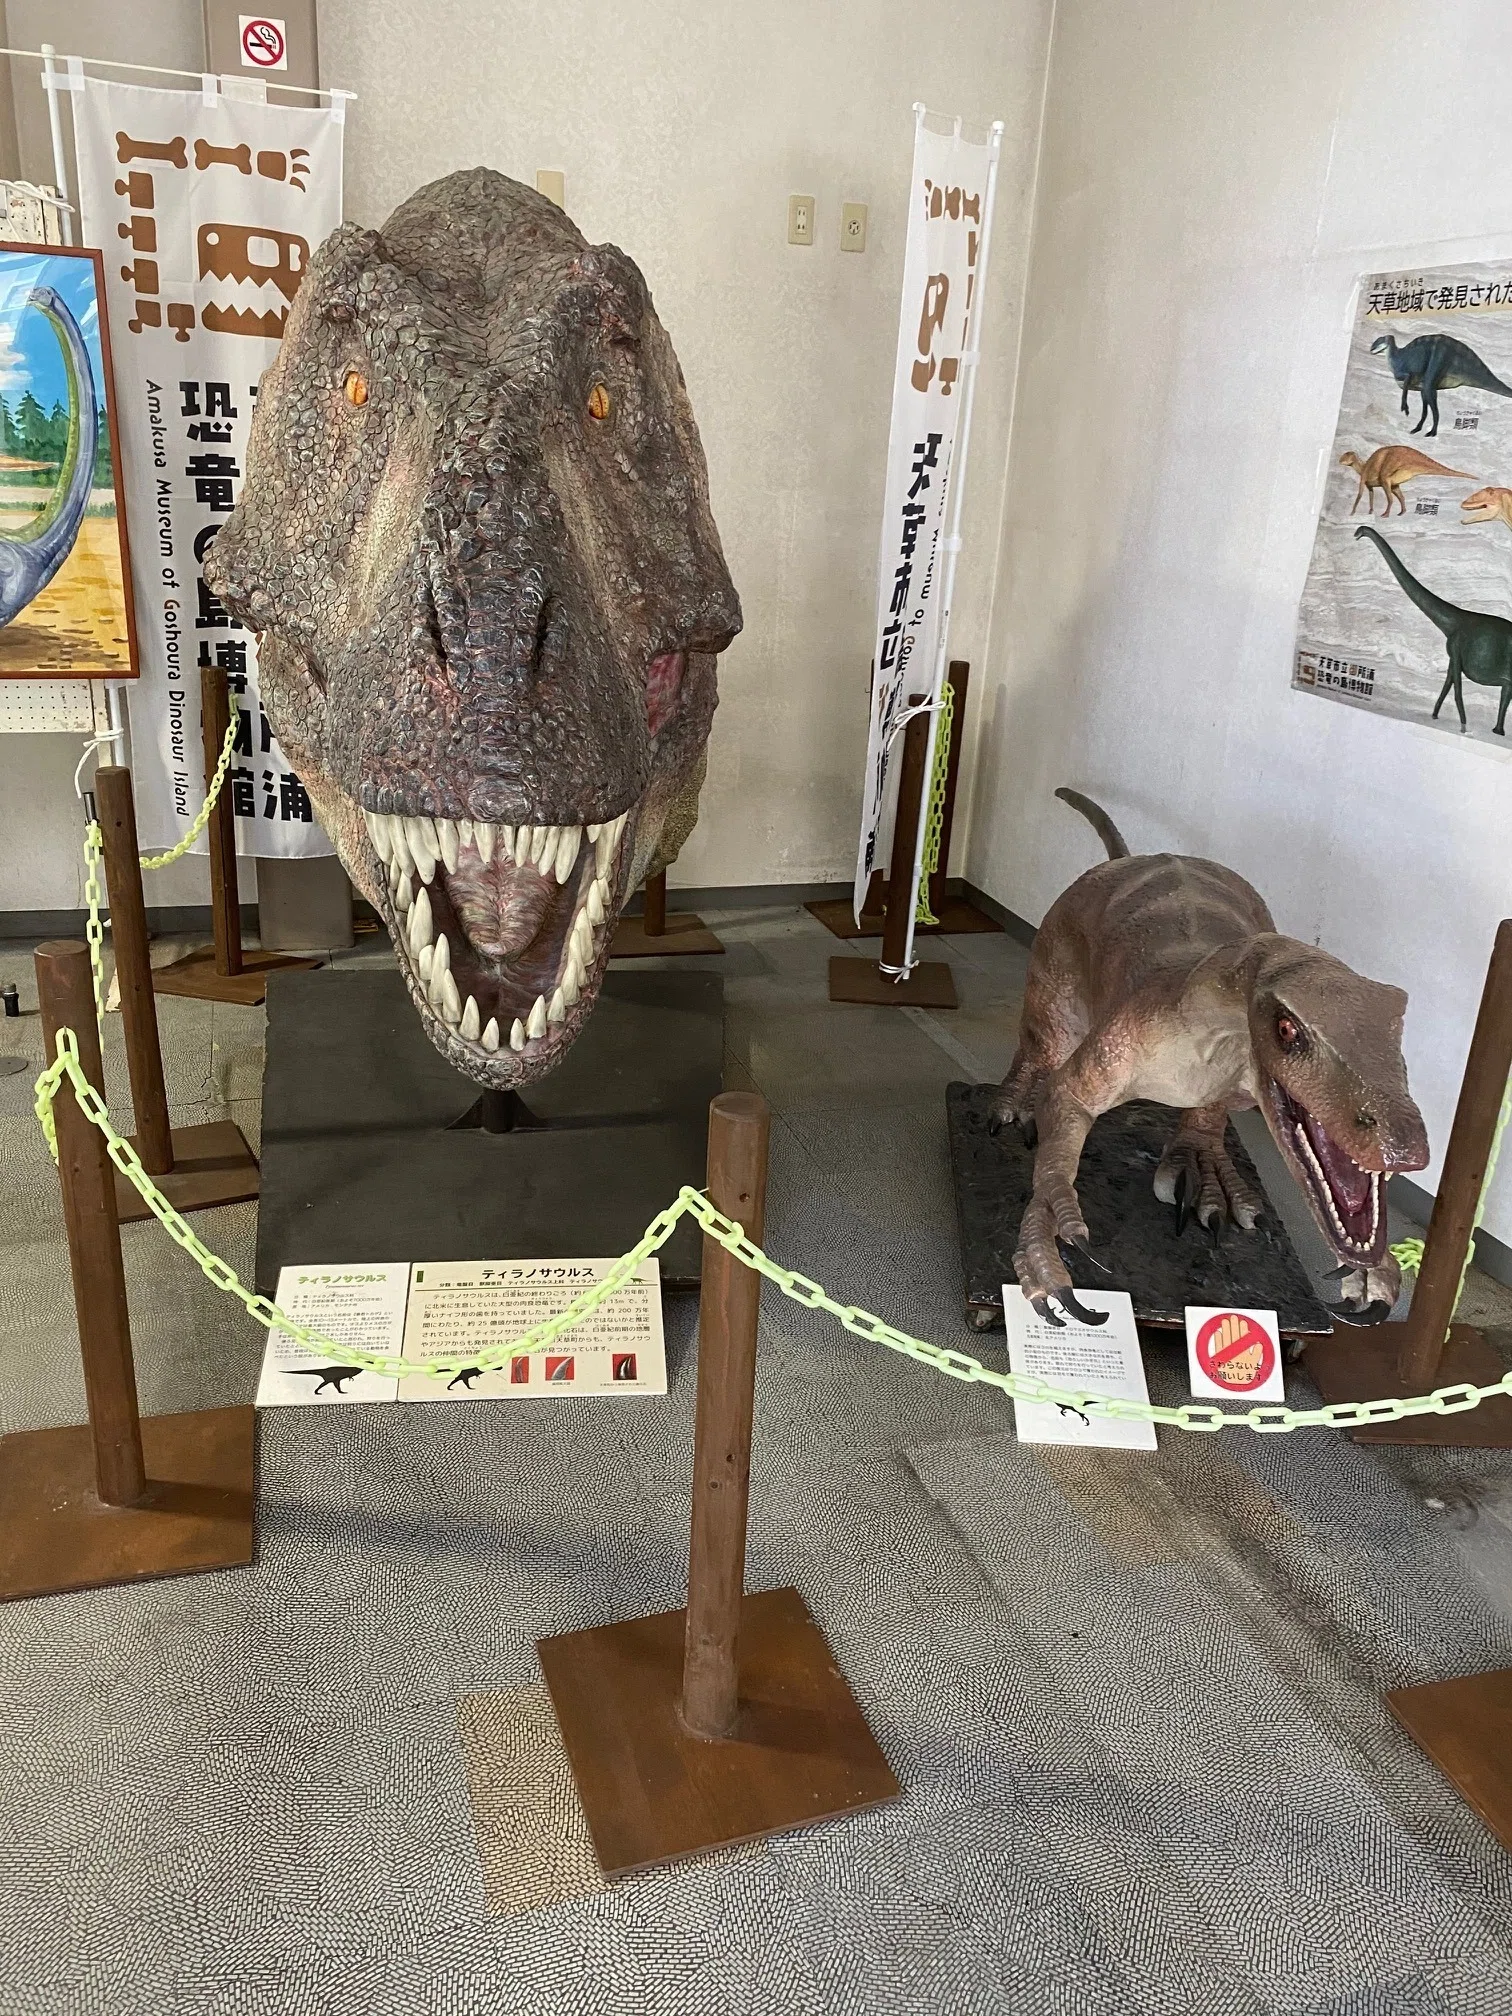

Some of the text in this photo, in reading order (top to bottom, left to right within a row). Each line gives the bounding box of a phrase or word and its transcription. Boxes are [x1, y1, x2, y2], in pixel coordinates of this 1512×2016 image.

[145, 379, 189, 817] Amakusa Museum of Goshoura Dinosaur Island
[298, 1274, 387, 1285] ティラノサウルス
[482, 1267, 594, 1280] ティラノサウルス
